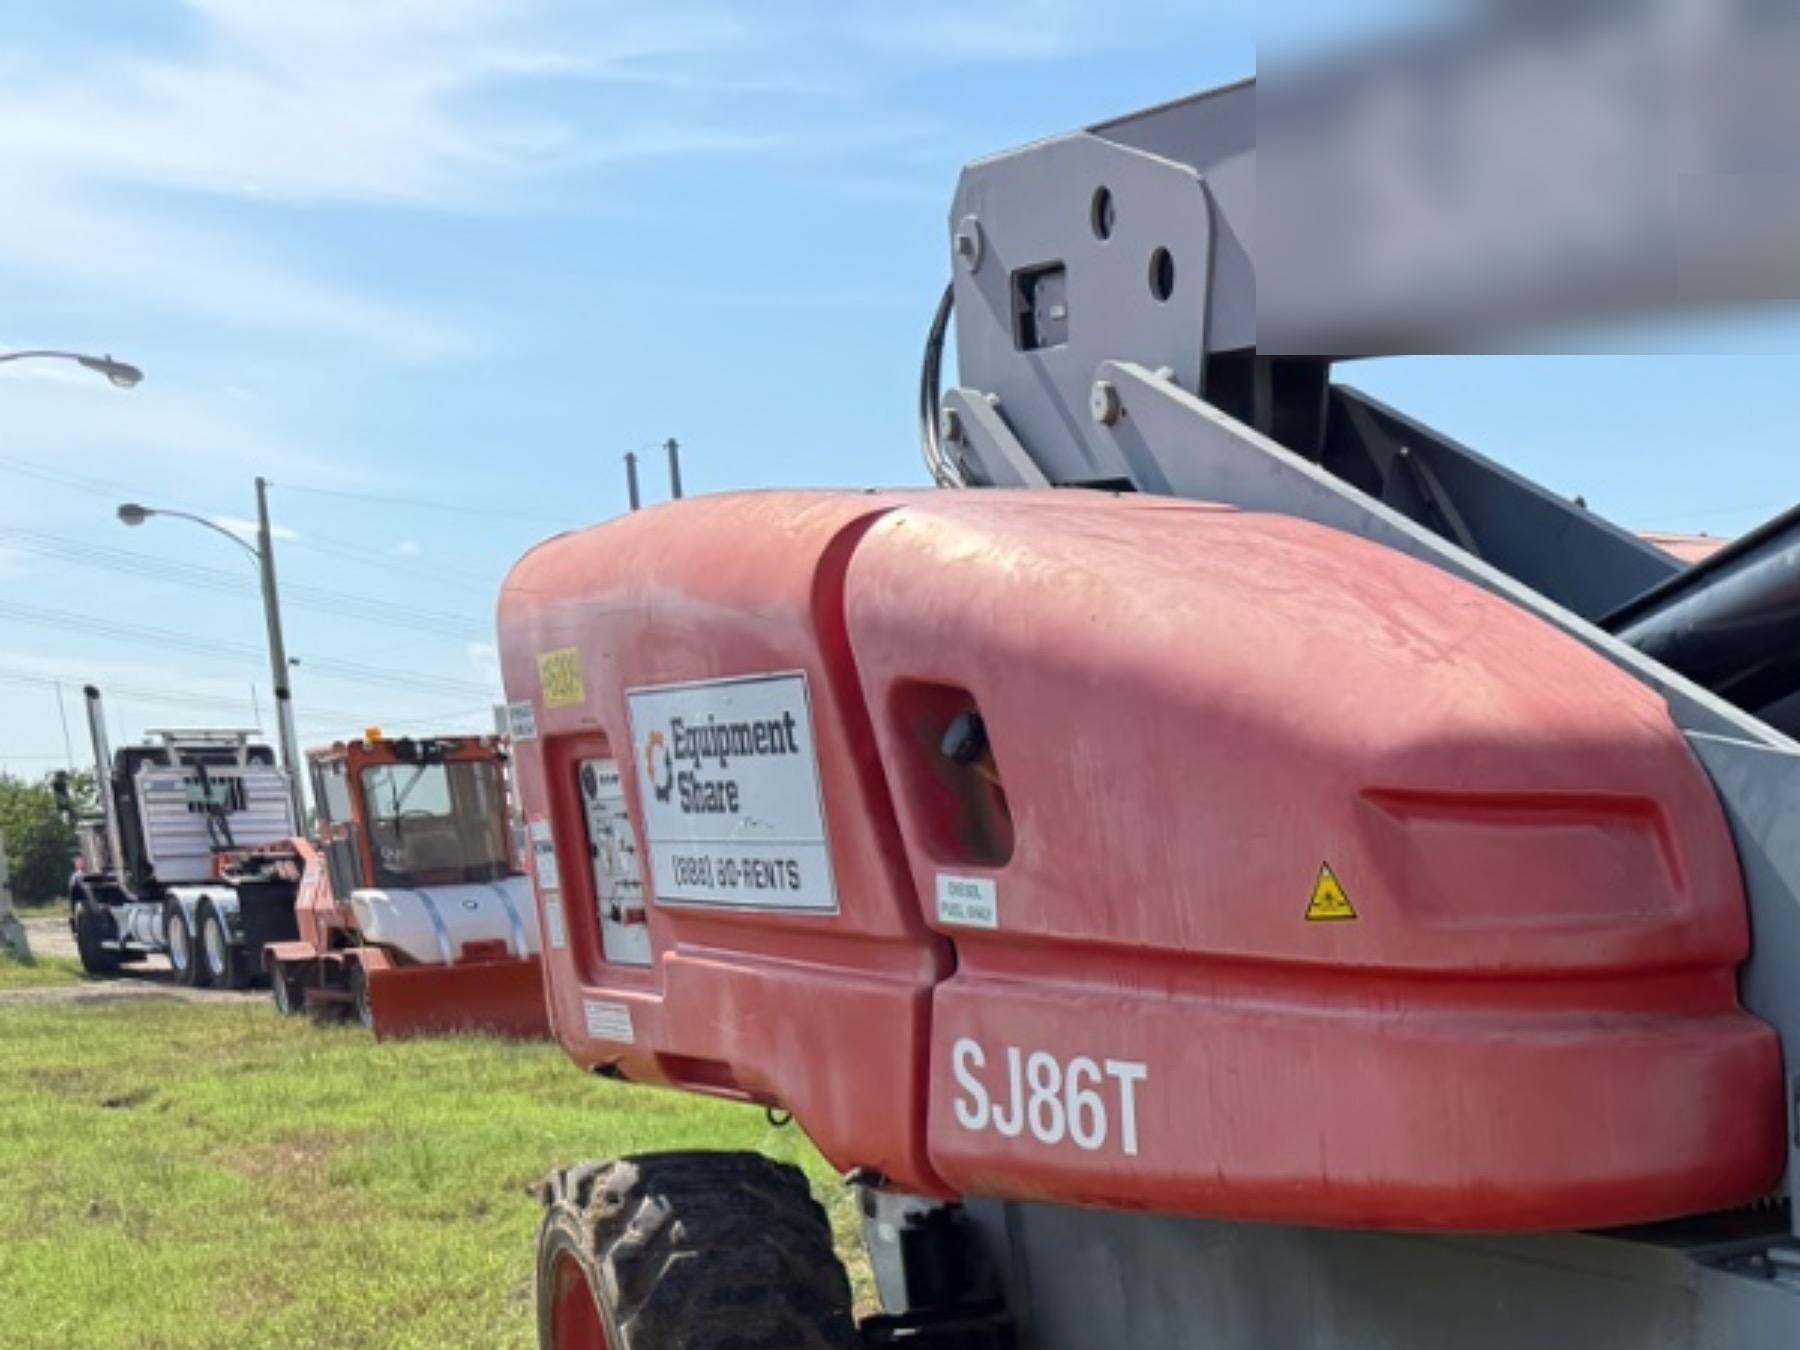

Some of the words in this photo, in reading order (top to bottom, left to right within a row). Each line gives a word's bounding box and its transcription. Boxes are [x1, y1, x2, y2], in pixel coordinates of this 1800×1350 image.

[670, 711, 800, 769] Equipment
[677, 770, 739, 814] Share
[716, 856, 801, 891] 80-RENTS
[952, 1036, 1147, 1156] SJ86T
